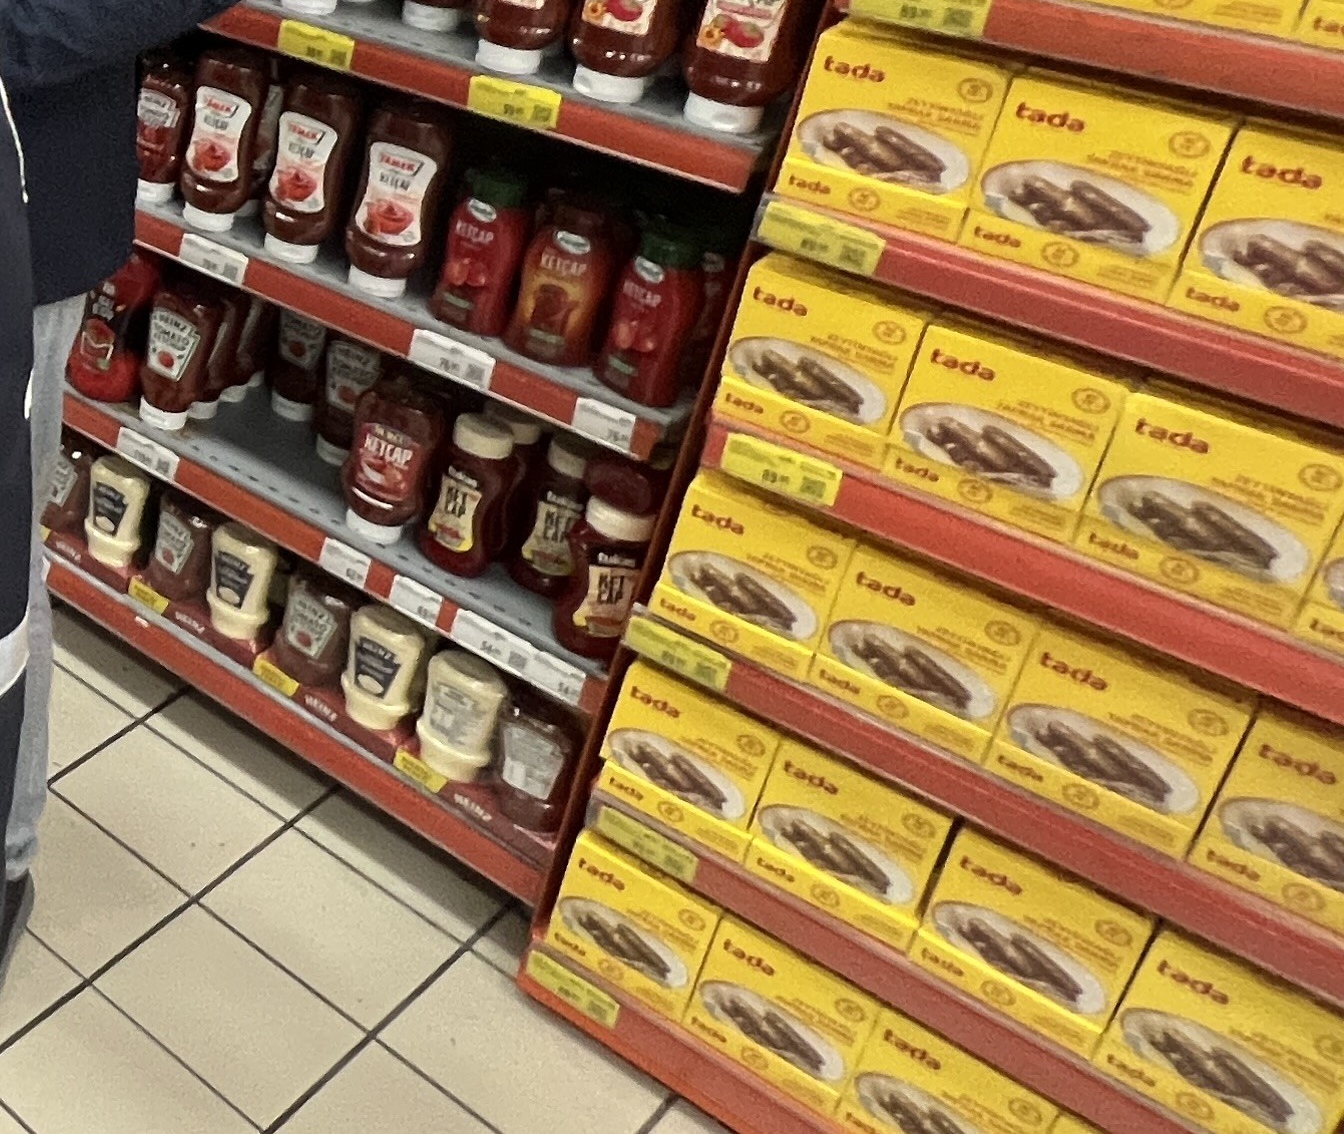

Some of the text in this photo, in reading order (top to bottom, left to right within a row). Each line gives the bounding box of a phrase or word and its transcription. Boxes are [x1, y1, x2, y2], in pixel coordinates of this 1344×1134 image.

[823, 55, 886, 83] tada
[1015, 101, 1086, 134] tada
[788, 172, 832, 197] tada
[1240, 154, 1323, 190] tada
[973, 224, 1022, 249] tada
[540, 251, 588, 276] KETÇAP
[752, 285, 809, 318] tada
[1183, 285, 1242, 314] tada
[929, 347, 997, 383] tada
[723, 392, 765, 416] tada
[1133, 416, 1211, 456] tada
[893, 456, 941, 485] tada
[689, 502, 746, 537] tada
[1087, 531, 1142, 562] tada
[853, 570, 917, 608] tada
[658, 596, 697, 623] tada
[1307, 615, 1344, 640] tad
[818, 667, 862, 695] tada
[1039, 651, 1109, 692] tada
[304, 694, 338, 721] HEINZ
[629, 684, 681, 720] tada
[783, 759, 841, 797] tada
[994, 750, 1045, 784] tada
[1256, 743, 1339, 787] tada
[607, 775, 645, 802] tada
[578, 854, 627, 893] tada
[755, 854, 797, 884] tada
[959, 854, 1025, 897] tada
[1204, 847, 1261, 883] tada
[552, 930, 587, 958] tada
[720, 937, 778, 978] tada
[920, 945, 965, 979] tada
[1155, 957, 1231, 1007] tada
[689, 1014, 728, 1044] tada
[882, 1026, 943, 1071] tada
[1106, 1053, 1158, 1088] tada
